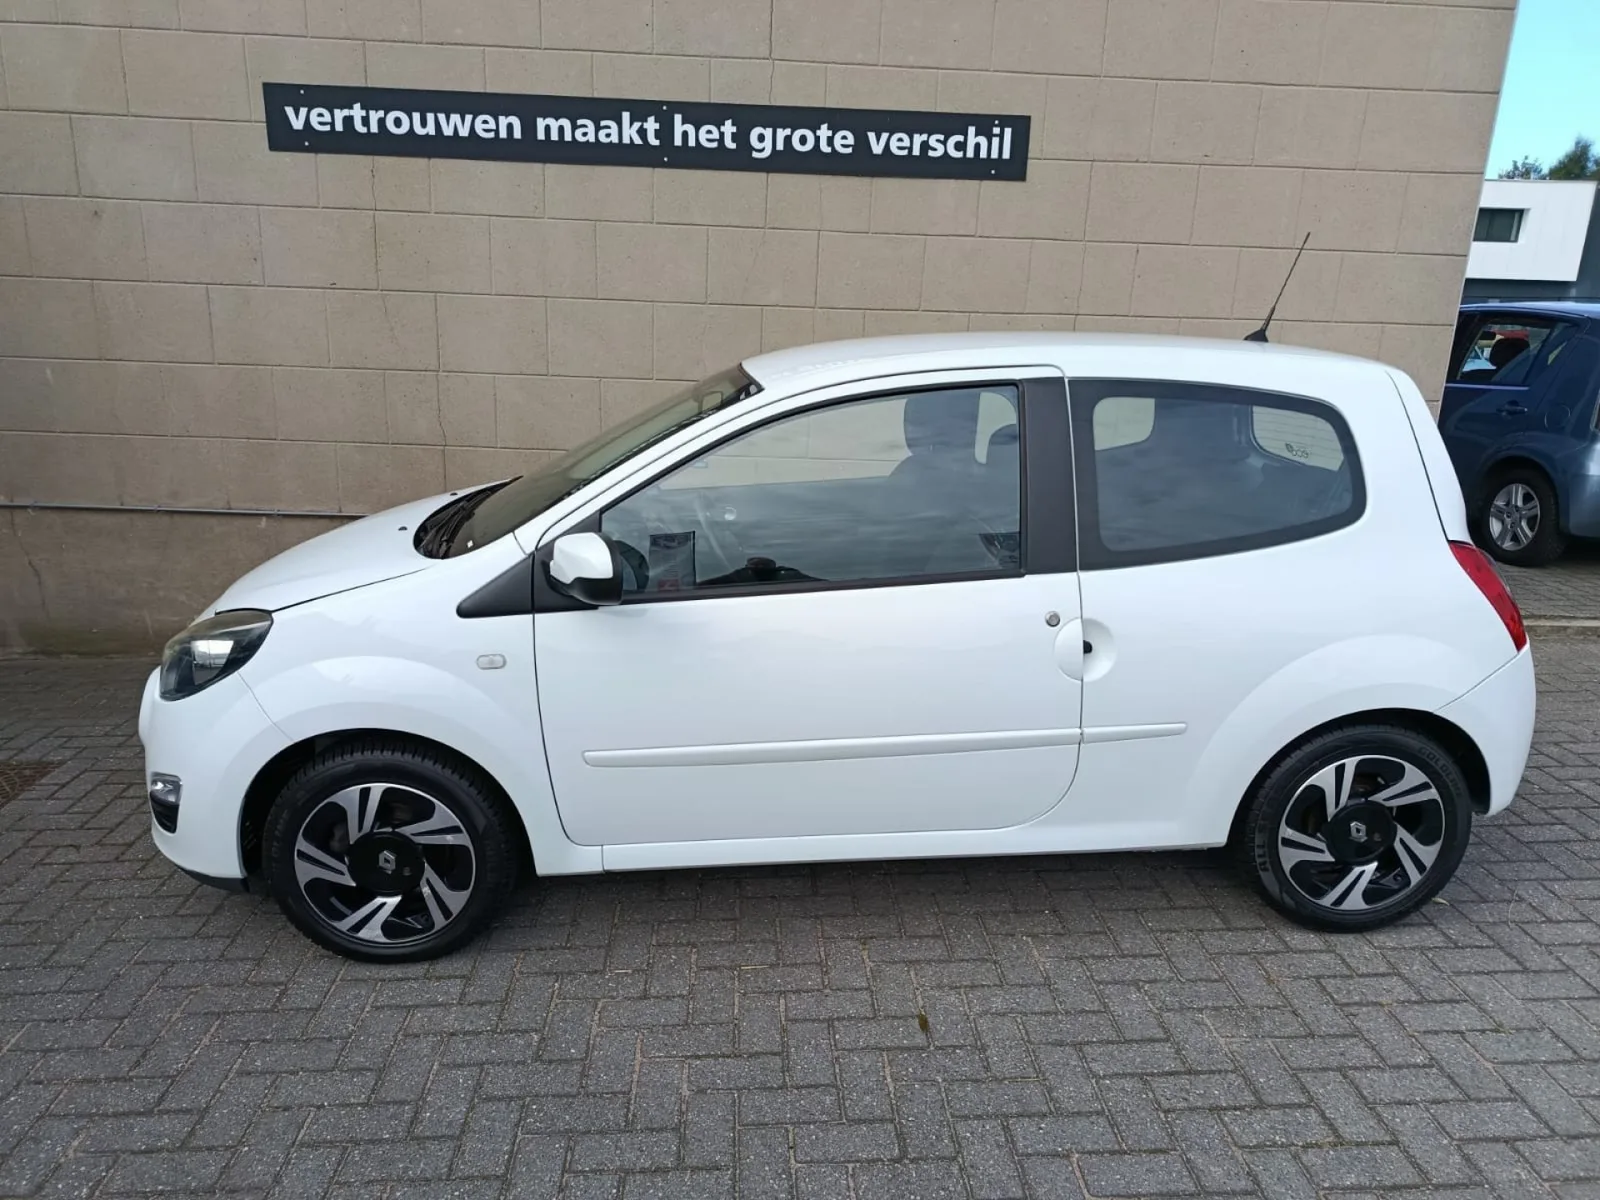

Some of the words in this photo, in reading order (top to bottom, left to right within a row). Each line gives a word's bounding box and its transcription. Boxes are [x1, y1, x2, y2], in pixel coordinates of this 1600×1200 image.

[284, 102, 522, 140] vertrouwen
[536, 111, 661, 147] maakt
[673, 113, 737, 150] het
[749, 122, 856, 160] grote
[866, 125, 1013, 161] verschil
